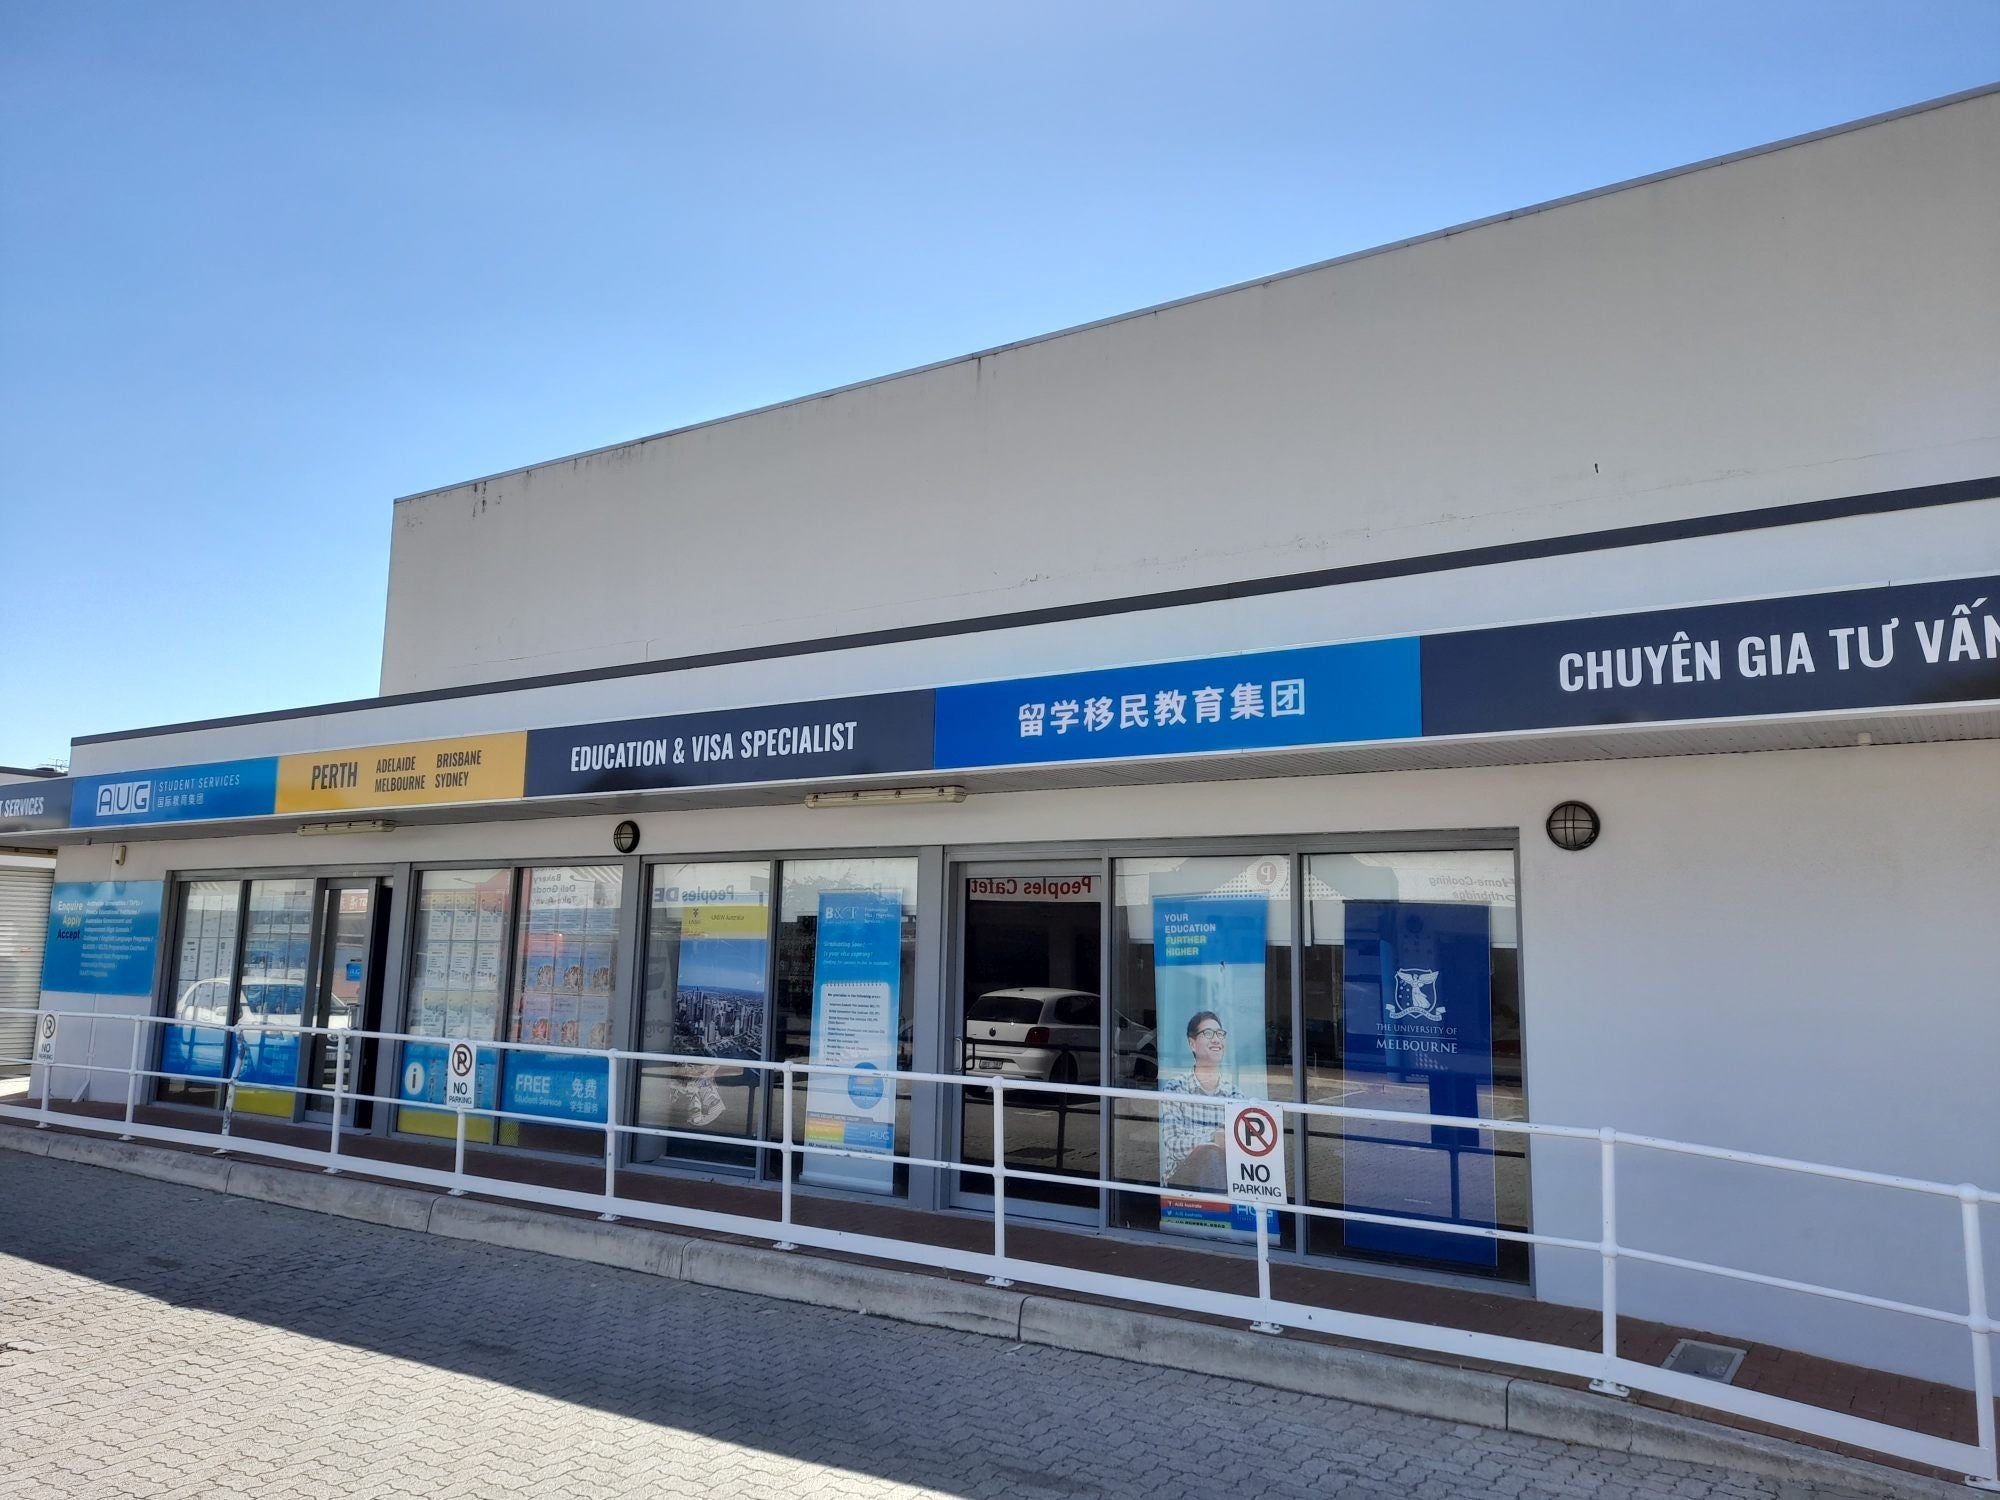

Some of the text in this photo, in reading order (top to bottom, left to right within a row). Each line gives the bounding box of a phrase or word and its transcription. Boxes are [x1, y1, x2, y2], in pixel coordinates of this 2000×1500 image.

[1559, 632, 1721, 692] CHUYÊN
[1737, 632, 1816, 678] GIA
[1828, 617, 1900, 669] TƯ
[1018, 678, 1306, 738] 留学移民教育集团
[571, 721, 858, 772] EDUCATION & VISA SPECIALIST
[376, 750, 482, 774] ADELAIDE BRISBANE
[158, 774, 240, 793] STUDENT SERVICES
[311, 761, 359, 791] PERTH
[374, 771, 469, 793] MELBOURNE SYDNEY
[4, 796, 45, 818] SERVICES
[98, 783, 149, 814] AUG
[58, 900, 83, 914] Enquire
[62, 915, 82, 928] Apply
[1164, 913, 1189, 923] YOUR
[57, 929, 81, 941] Accept
[1164, 923, 1217, 934] EDUCATION
[1165, 935, 1208, 946] FURTHER
[1165, 946, 1199, 957] HIGHER
[1376, 1023, 1458, 1035] THE UNIVERSITY OF
[1376, 1039, 1458, 1053] MELBOURNE
[453, 1082, 467, 1095] NO
[515, 1074, 550, 1094] FREE
[571, 1077, 597, 1099] 免费
[448, 1095, 473, 1105] PARKING
[1240, 1162, 1271, 1183] NO
[1232, 1183, 1282, 1198] PARKING
